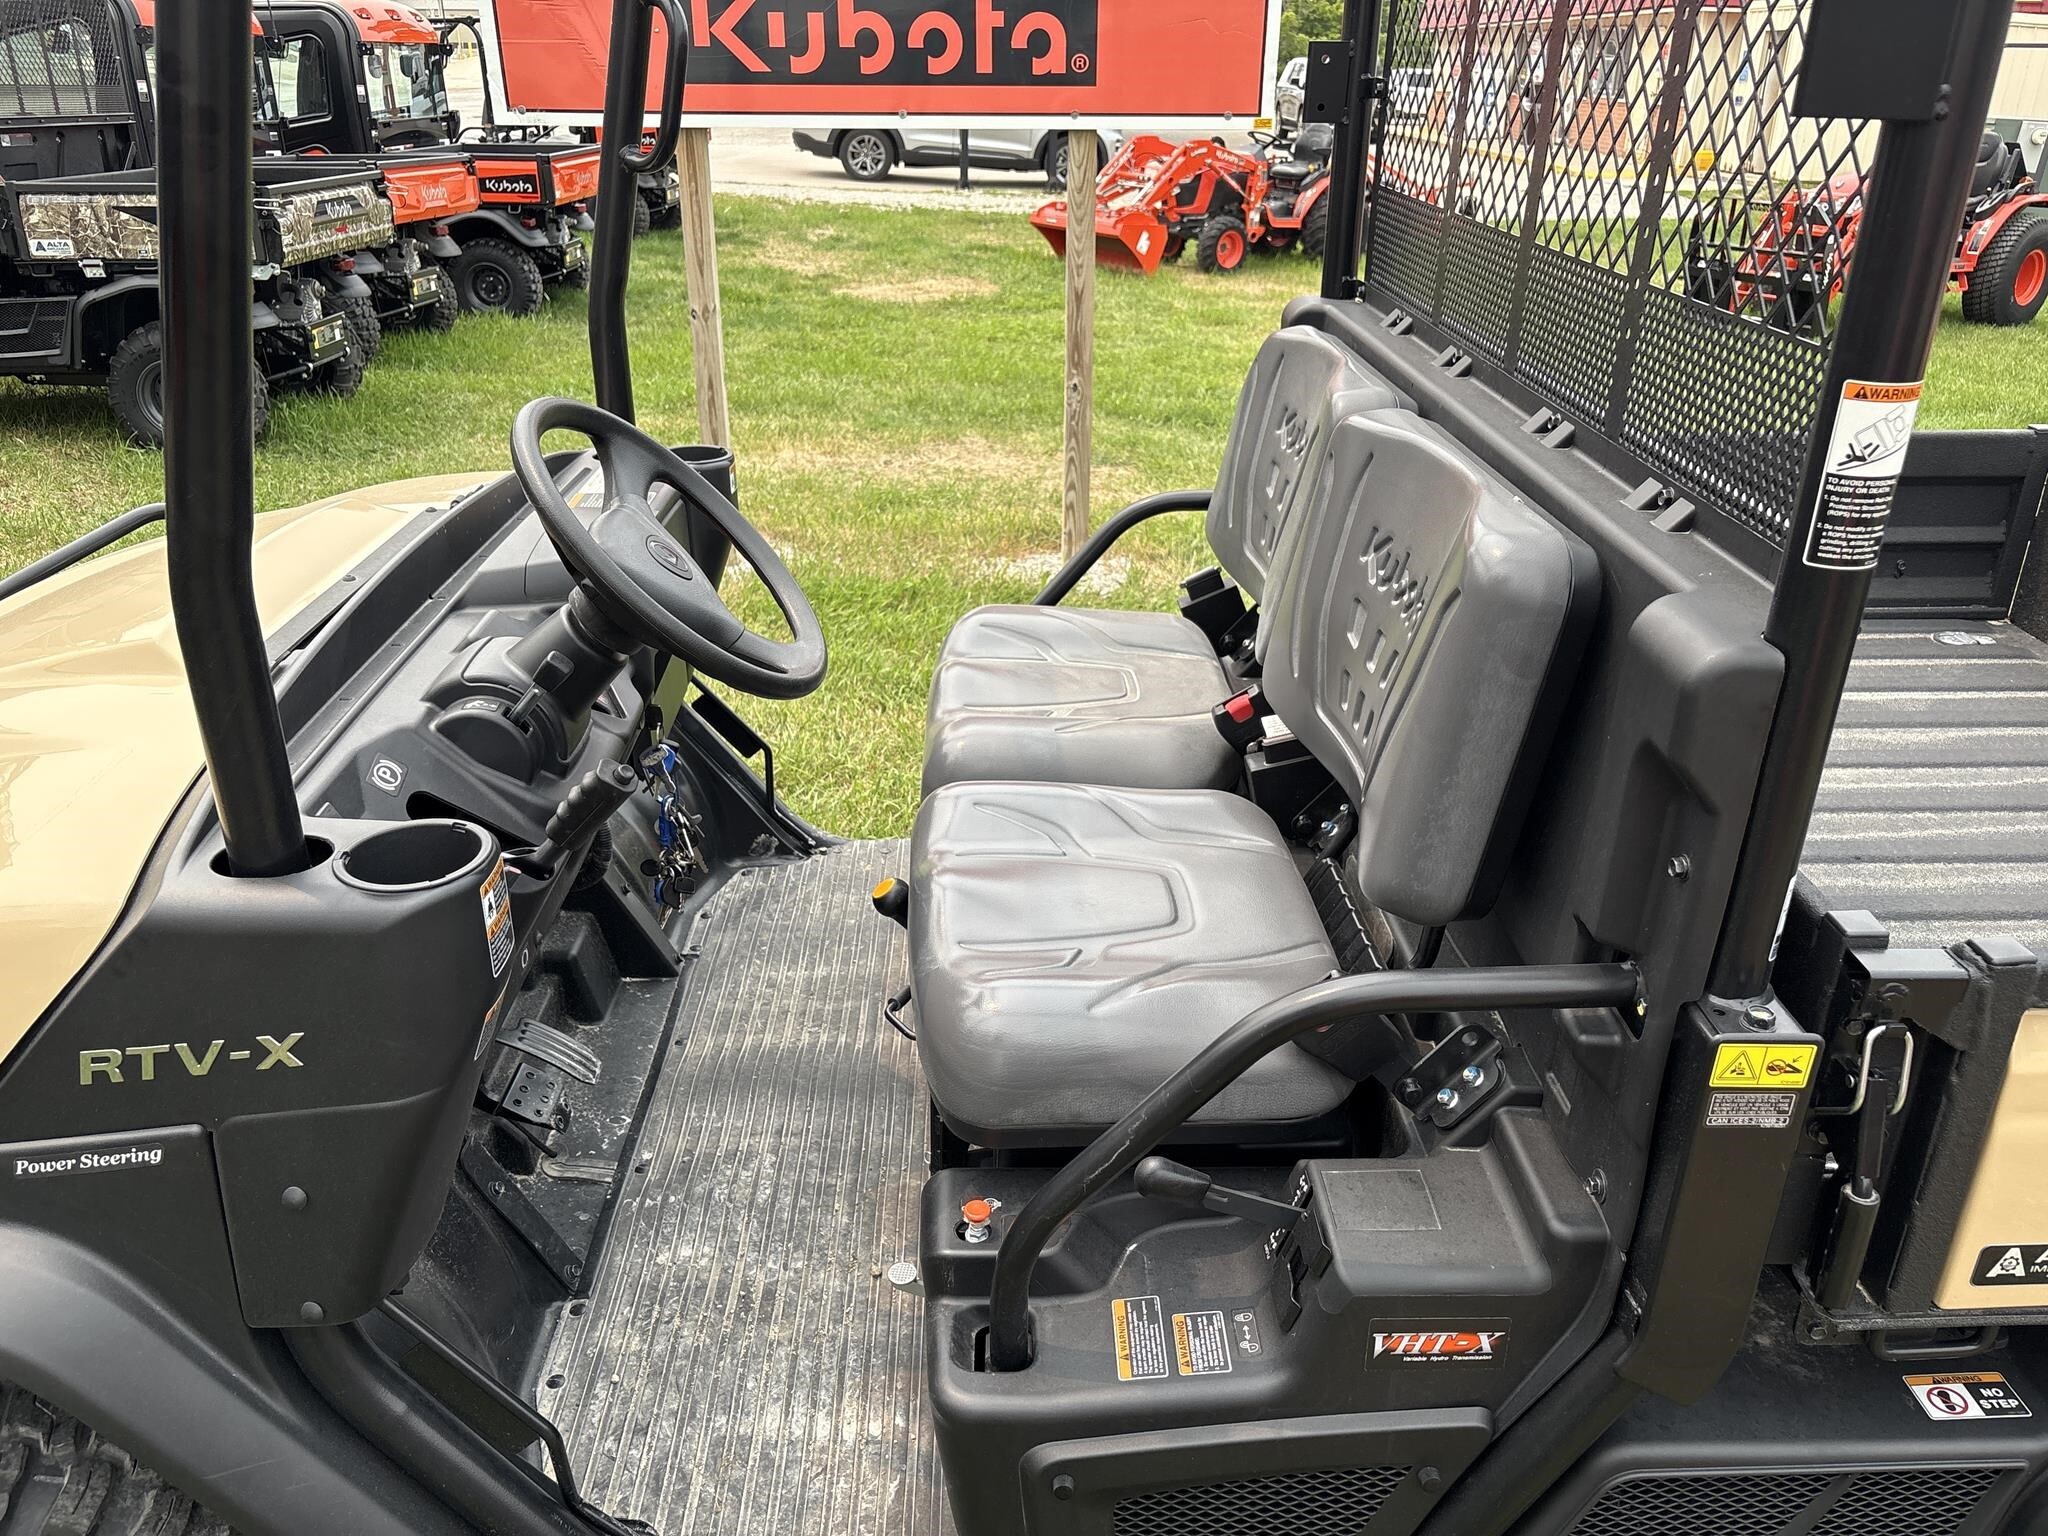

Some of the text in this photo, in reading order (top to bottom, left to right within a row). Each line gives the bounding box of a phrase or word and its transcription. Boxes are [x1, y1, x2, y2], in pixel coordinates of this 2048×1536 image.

[690, 0, 1067, 75] Kubota
[421, 184, 448, 201] Kubota
[485, 179, 533, 193] Kubota
[325, 200, 353, 220] Kubota
[1826, 484, 1854, 493] INJURY
[1840, 478, 1864, 486] AVOID
[79, 1032, 305, 1086] RTV-X
[1711, 1117, 1728, 1125] CAN
[15, 1147, 163, 1175] Power Steering
[1119, 1315, 1129, 1352] WARNING
[1176, 1320, 1189, 1359] WARNING
[1373, 1332, 1505, 1359] VHT-X
[1940, 1375, 1982, 1384] WARNING
[1979, 1388, 2004, 1397] NO
[1980, 1399, 2020, 1409] STEP
